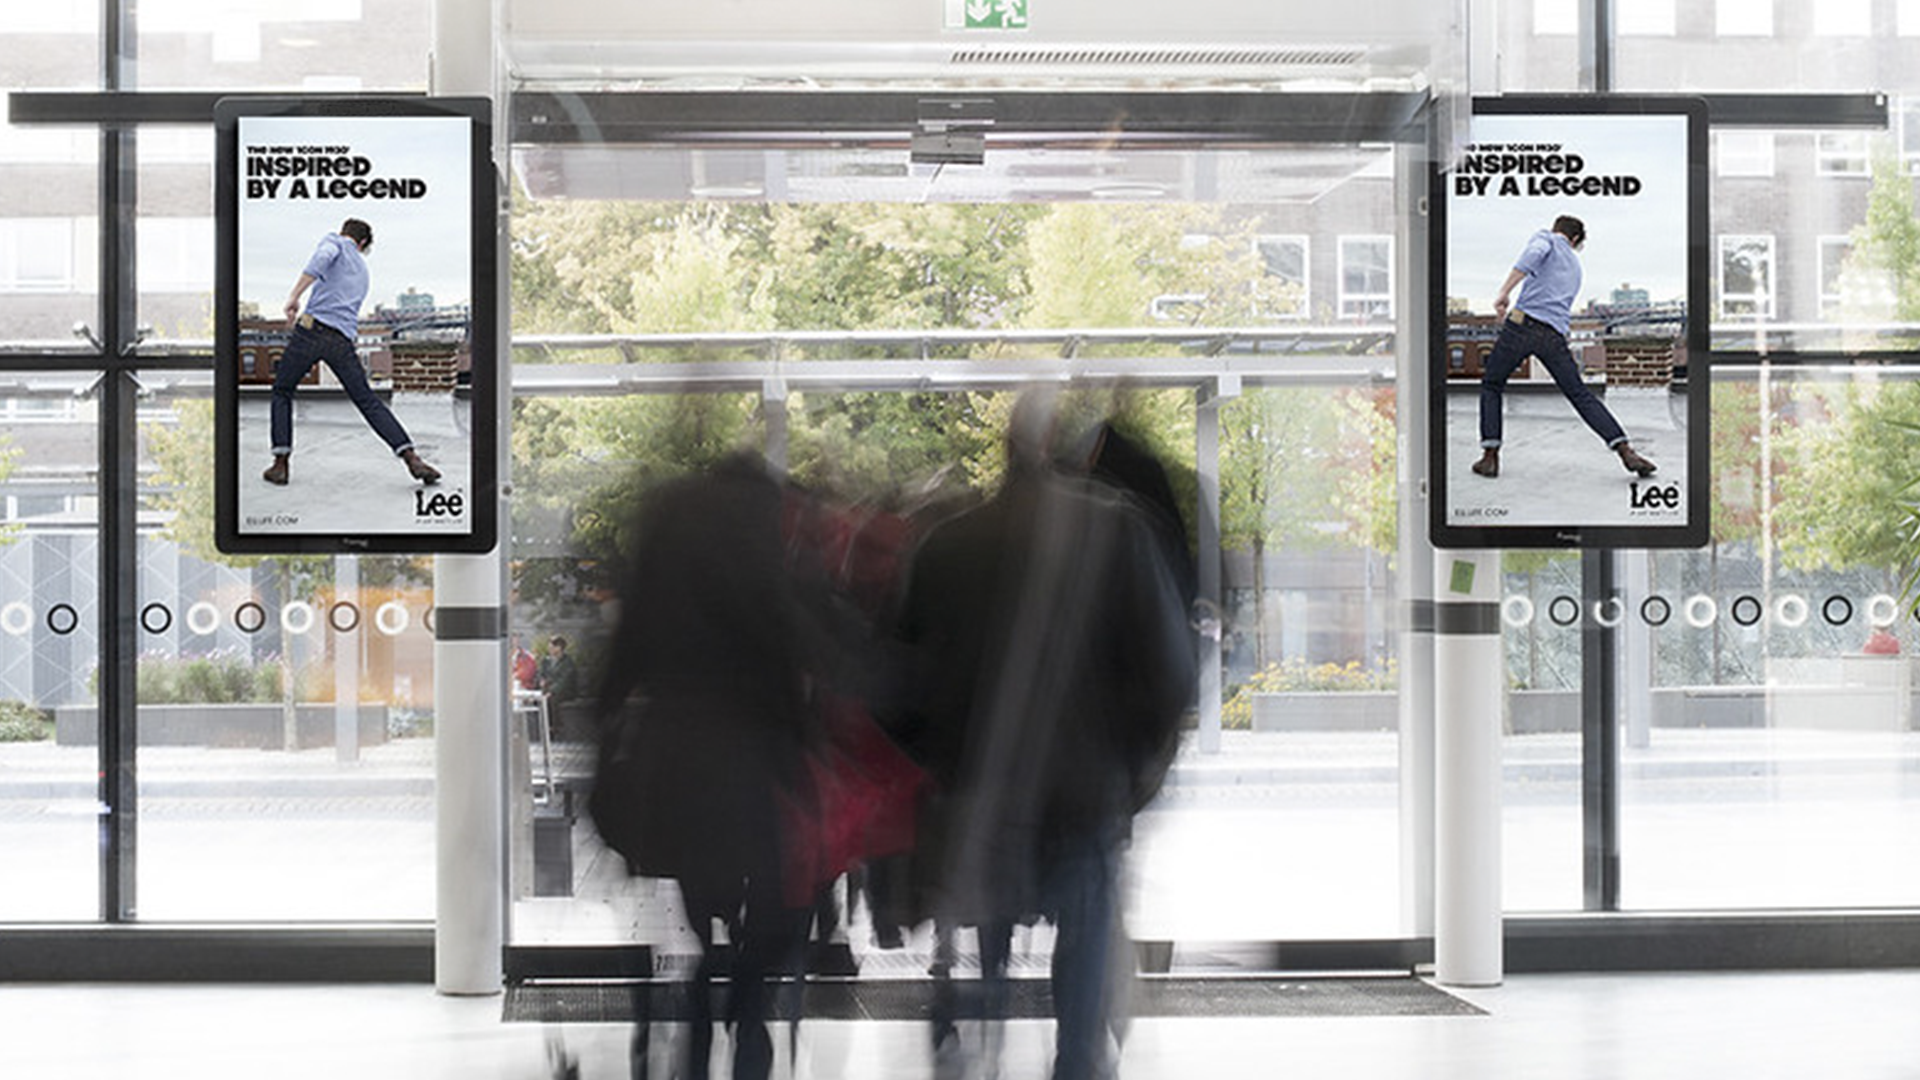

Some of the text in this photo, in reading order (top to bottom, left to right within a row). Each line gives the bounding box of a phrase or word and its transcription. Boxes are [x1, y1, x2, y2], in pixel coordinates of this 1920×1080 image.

[247, 179, 281, 199] BY
[289, 179, 310, 199] A
[1455, 176, 1491, 196] BY
[1499, 176, 1520, 196] A
[415, 489, 463, 517] Lee
[1630, 482, 1679, 508] Lee
